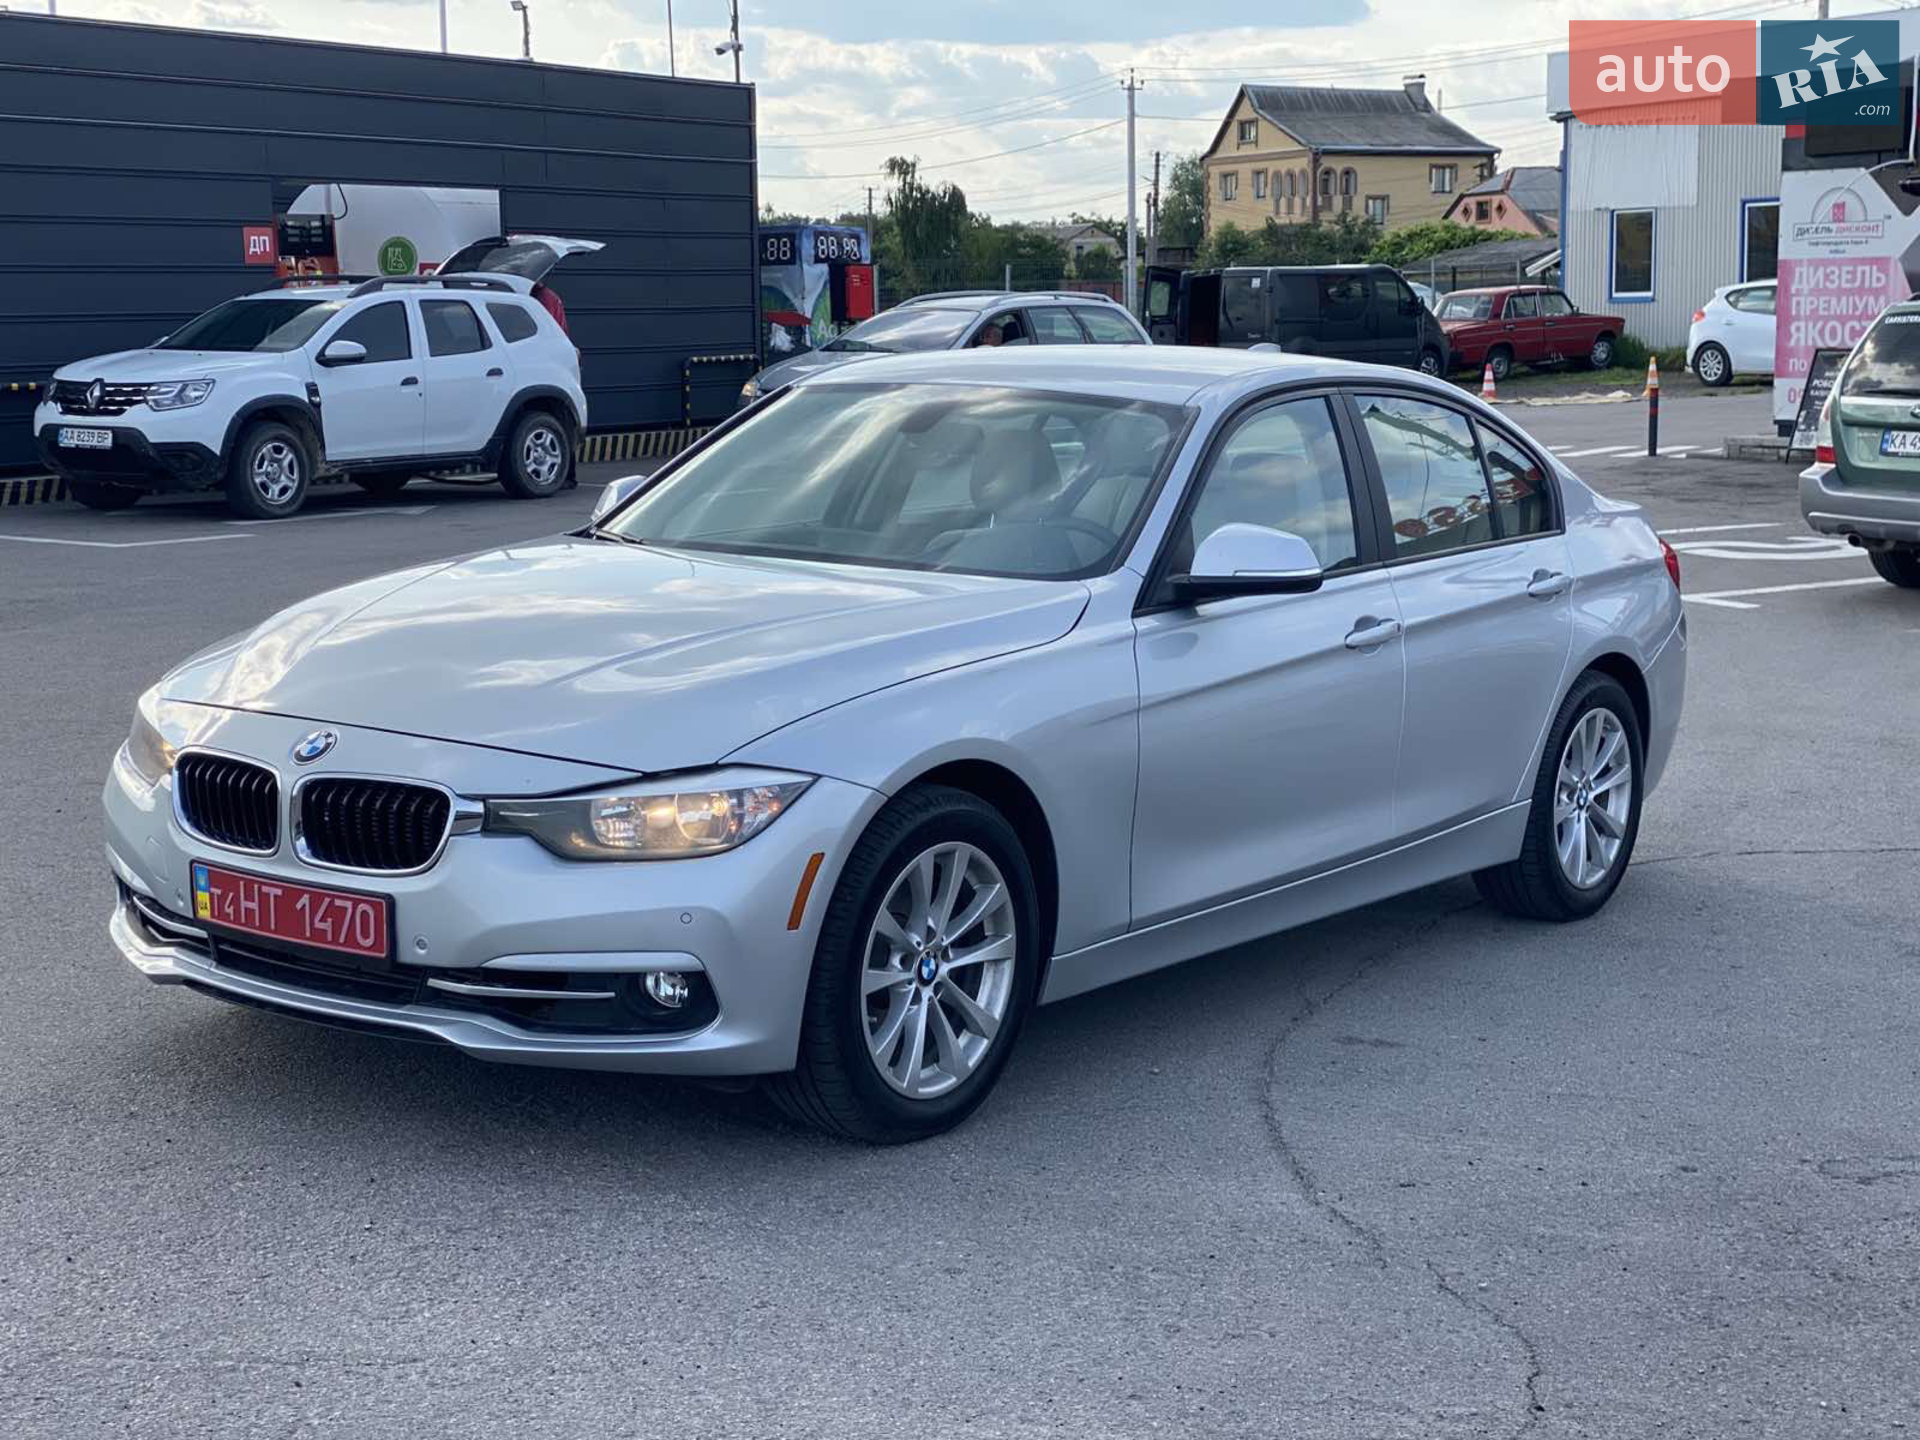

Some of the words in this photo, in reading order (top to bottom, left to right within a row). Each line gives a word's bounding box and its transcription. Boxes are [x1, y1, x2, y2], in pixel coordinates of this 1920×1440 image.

[249, 236, 270, 255] ДП
[1791, 264, 1886, 294] ДИЗЕЛЬ
[1791, 295, 1885, 317] ПРЕМІУМ
[295, 893, 375, 948] 1470
